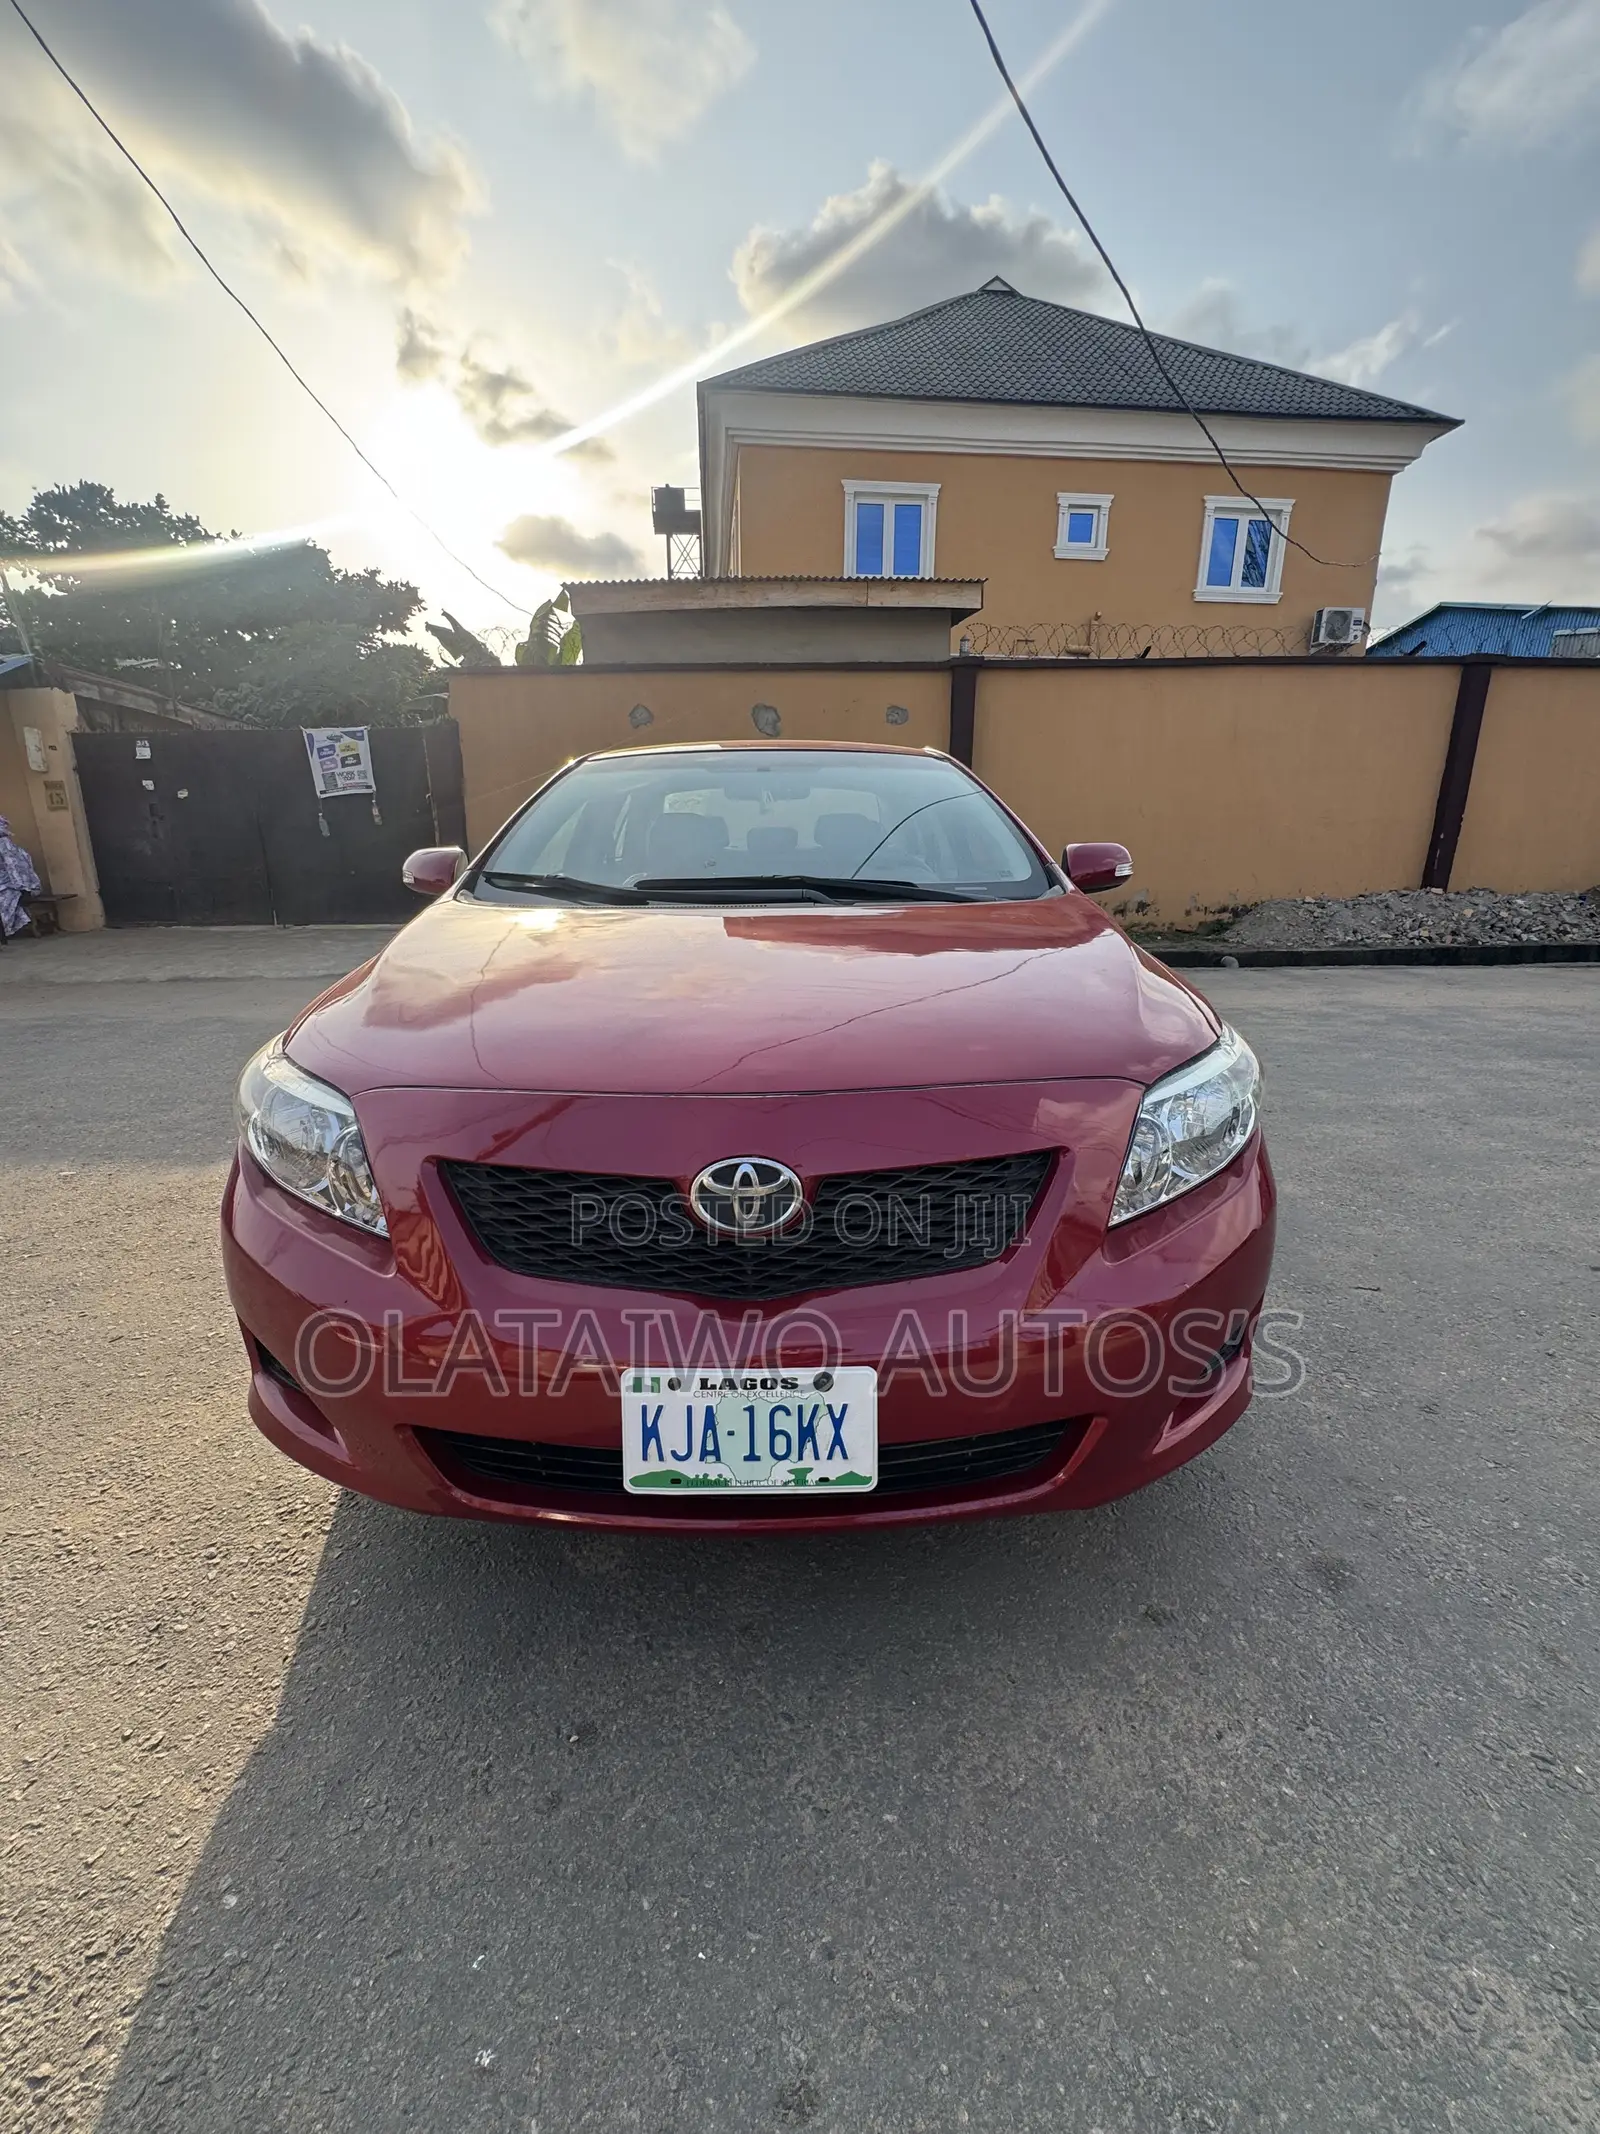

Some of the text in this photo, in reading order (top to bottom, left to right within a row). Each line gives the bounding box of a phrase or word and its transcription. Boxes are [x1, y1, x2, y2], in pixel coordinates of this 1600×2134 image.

[699, 1377, 799, 1390] LAGOS
[693, 1390, 805, 1399] CENTRE OF EXCELLENCE
[641, 1403, 849, 1462] KJA-16KX
